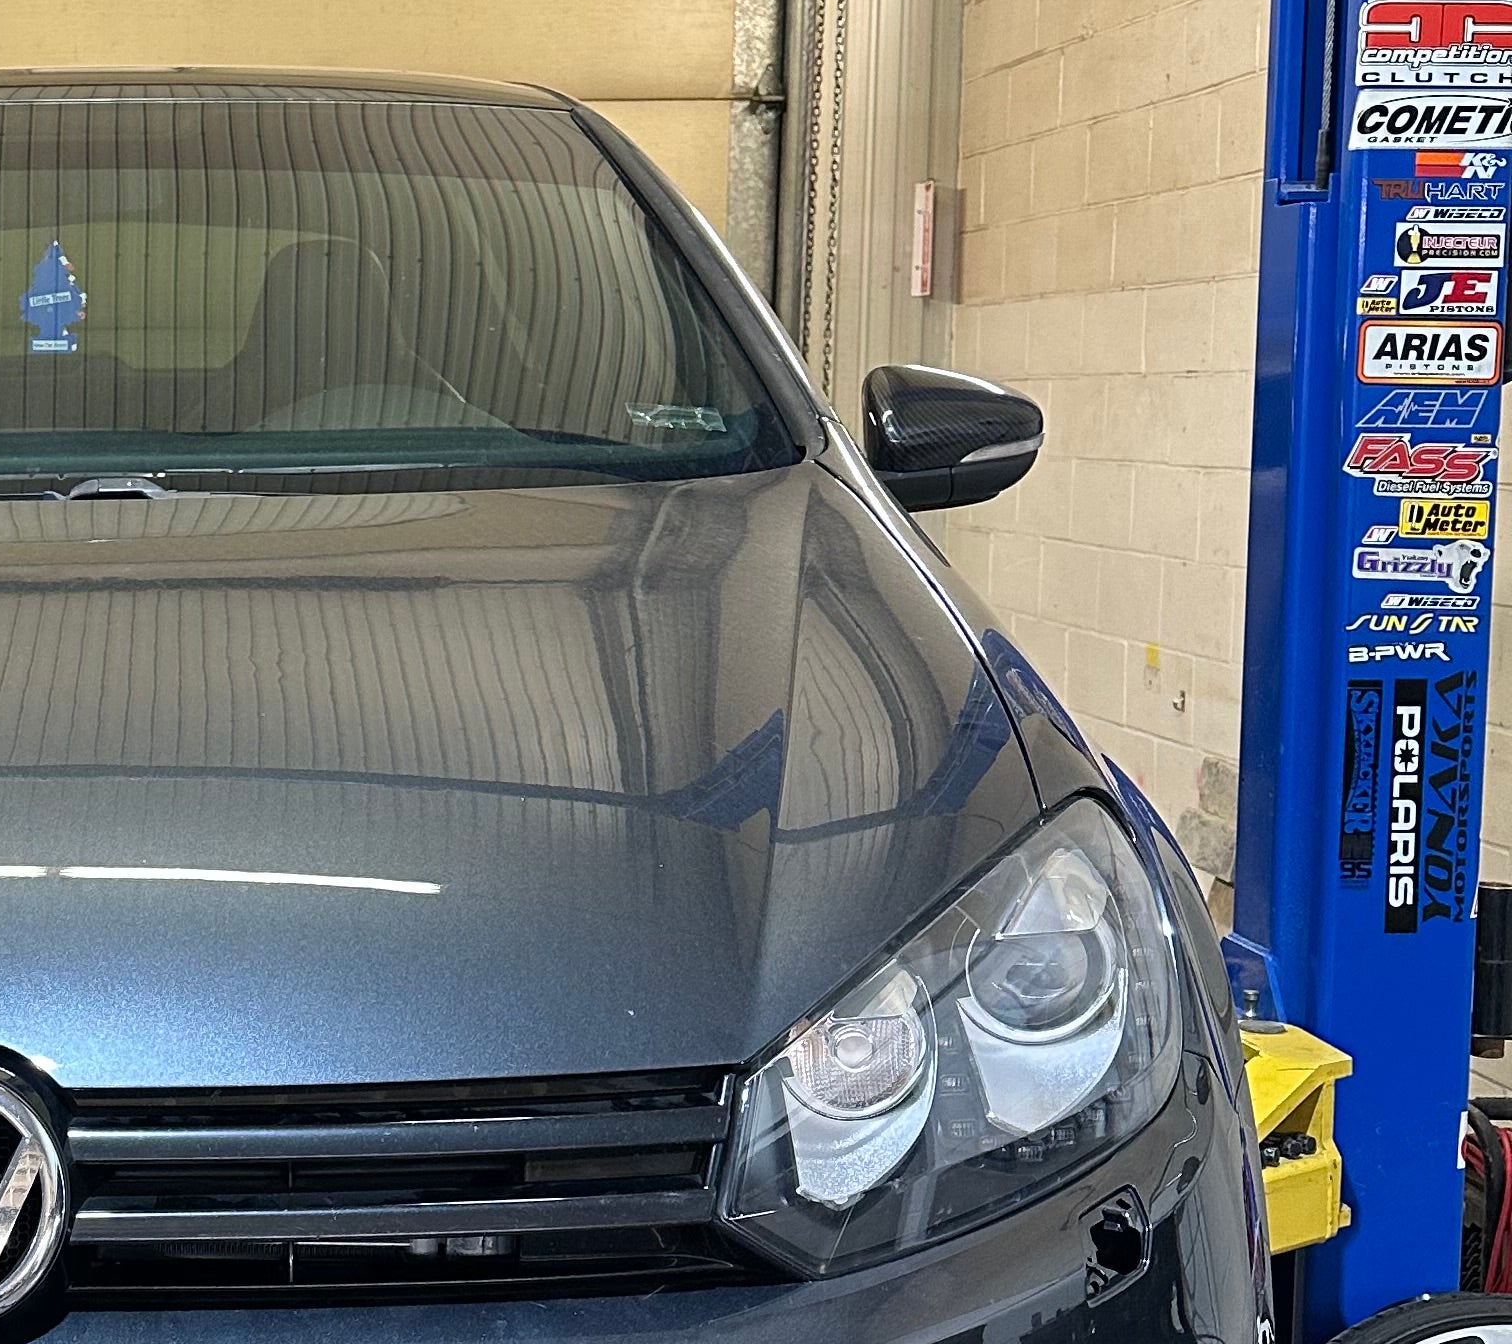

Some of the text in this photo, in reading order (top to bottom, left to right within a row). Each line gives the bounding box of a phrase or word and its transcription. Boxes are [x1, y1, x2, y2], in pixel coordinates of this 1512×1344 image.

[1357, 105, 1512, 135] COMETI
[1373, 179, 1506, 203] TRUHART
[1422, 236, 1498, 249] INJECTEUR
[1402, 272, 1493, 310] JE
[1372, 333, 1490, 362] ARIAS
[1348, 436, 1488, 482] FASS
[1378, 481, 1489, 494] Diesel Fuel Systems
[1427, 504, 1476, 518] Auto
[1422, 518, 1486, 535] Meter
[1358, 552, 1453, 578] Grizzly
[1389, 706, 1421, 907] POLARIS
[1423, 670, 1464, 922] YONAKA
[1453, 670, 1477, 922] MOTORSPORTS
